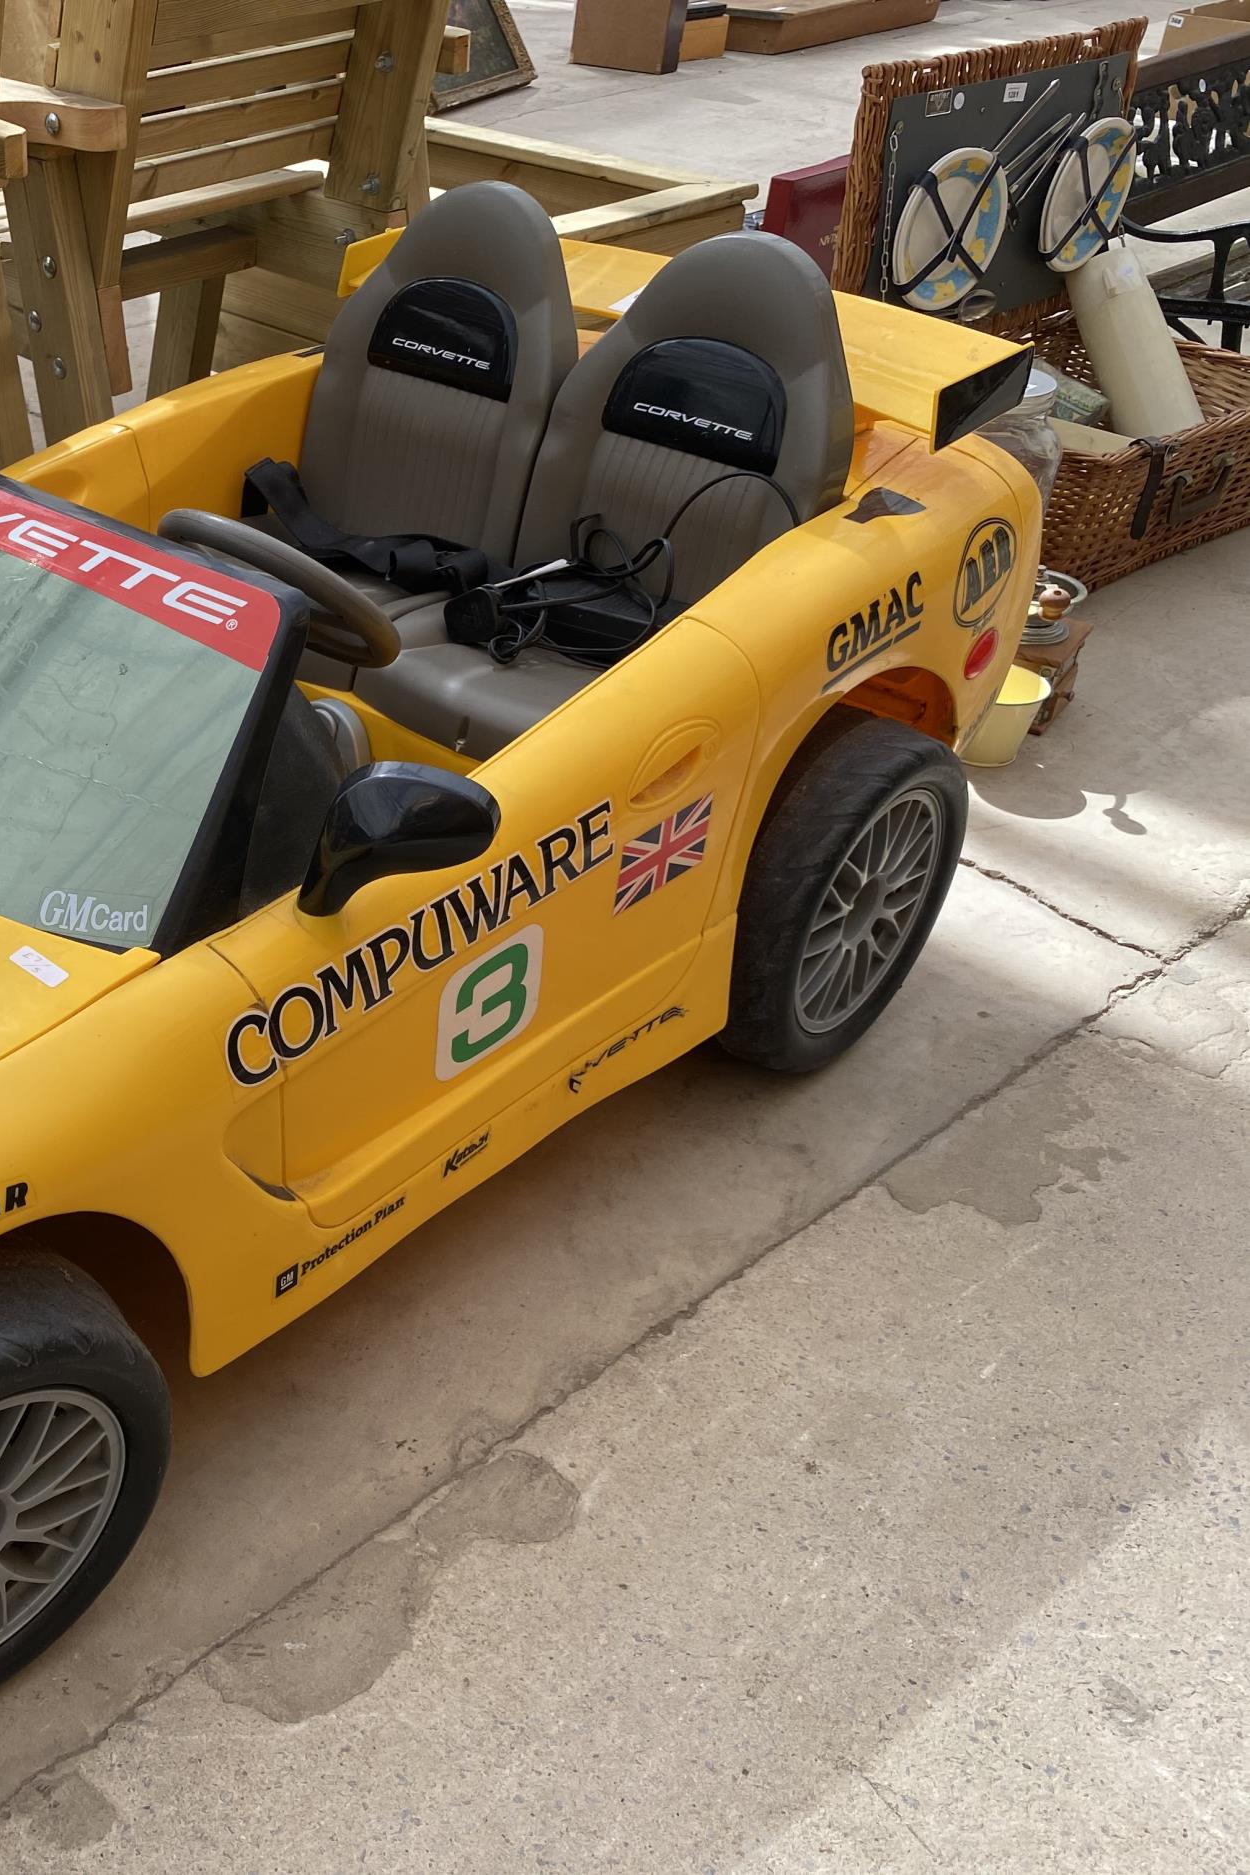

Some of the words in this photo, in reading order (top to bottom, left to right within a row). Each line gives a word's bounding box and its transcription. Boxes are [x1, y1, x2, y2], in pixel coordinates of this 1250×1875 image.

[392, 337, 490, 370] CORVETTE
[633, 402, 753, 441] CORVETTE
[827, 571, 924, 672] GMAC
[226, 799, 616, 1088] COMPUWARE
[451, 943, 528, 1064] 3
[280, 1271, 294, 1287] GM
[301, 1220, 372, 1277] Protection
[374, 1196, 405, 1226] Plan
